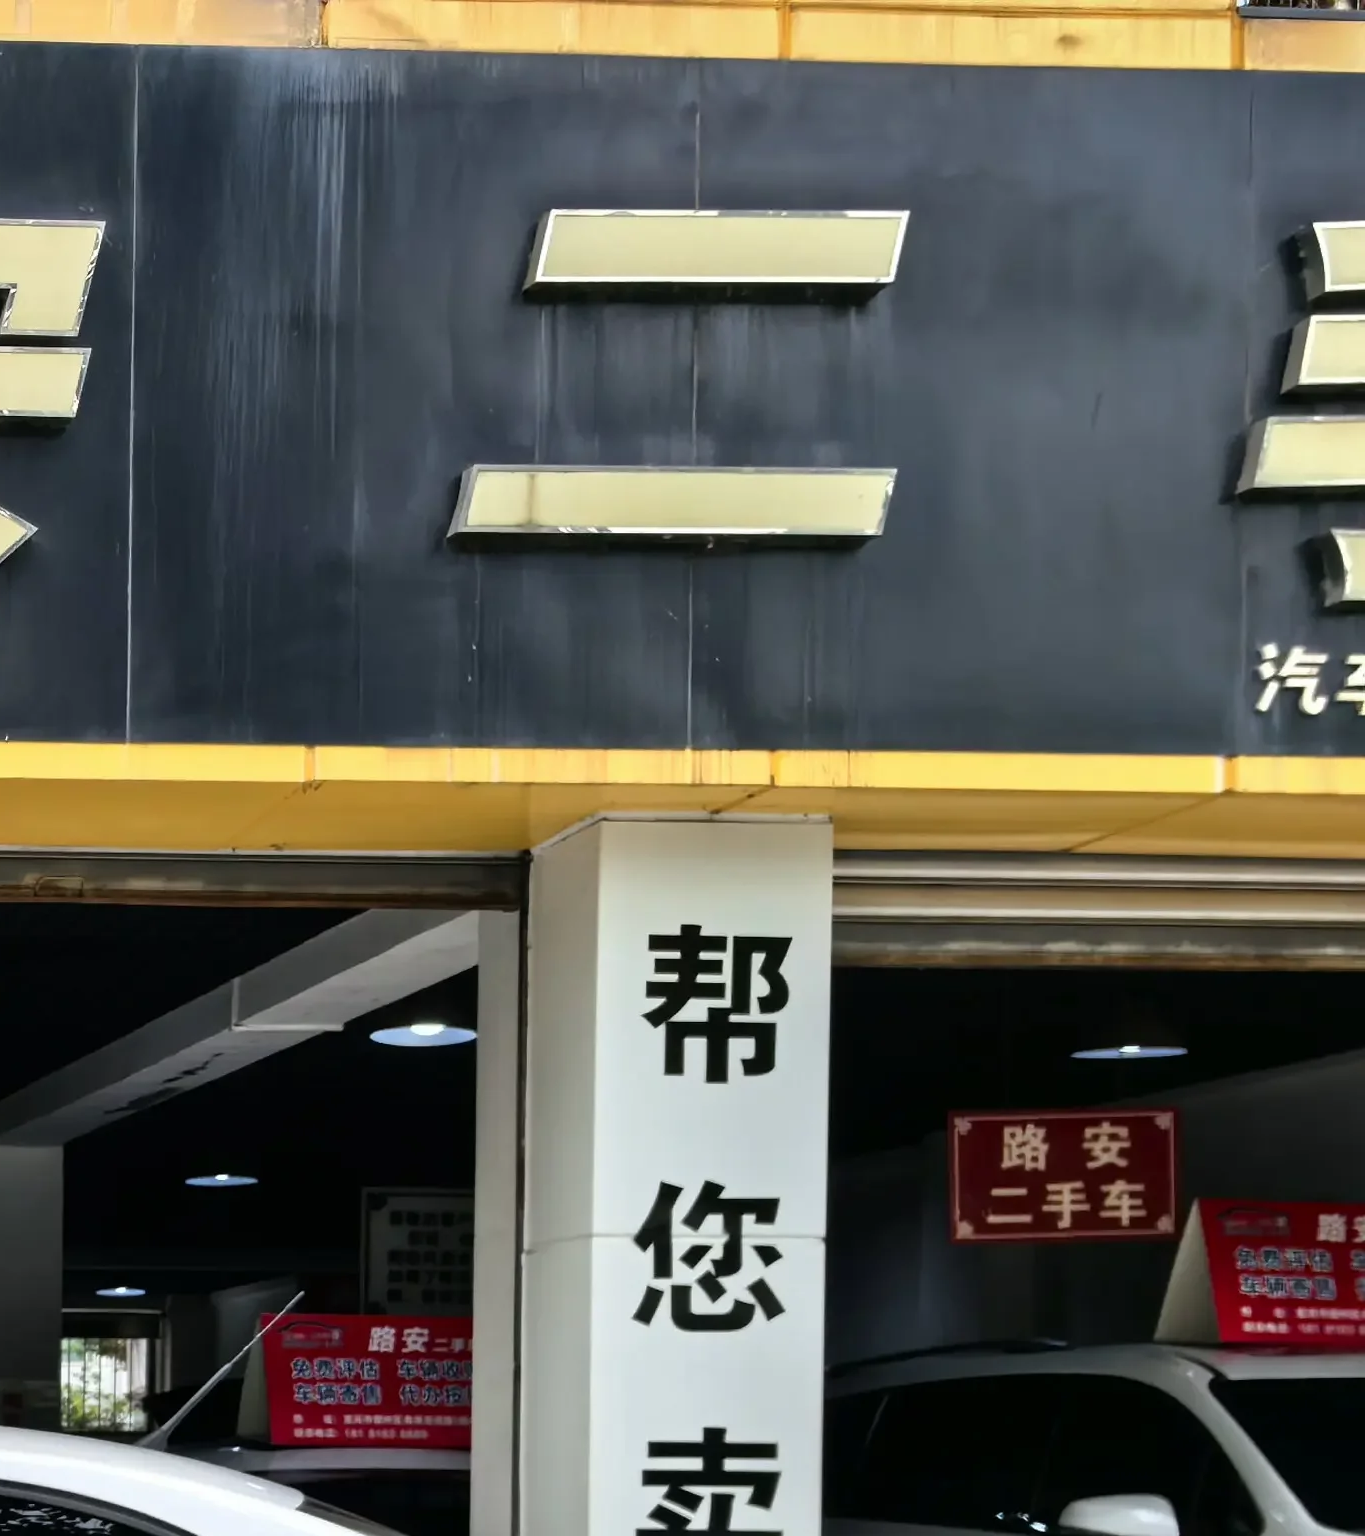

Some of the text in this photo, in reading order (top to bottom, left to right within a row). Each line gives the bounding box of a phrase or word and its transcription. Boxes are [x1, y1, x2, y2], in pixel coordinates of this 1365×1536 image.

[1001, 1122, 1131, 1171] 路安
[986, 1180, 1147, 1229] 二手车
